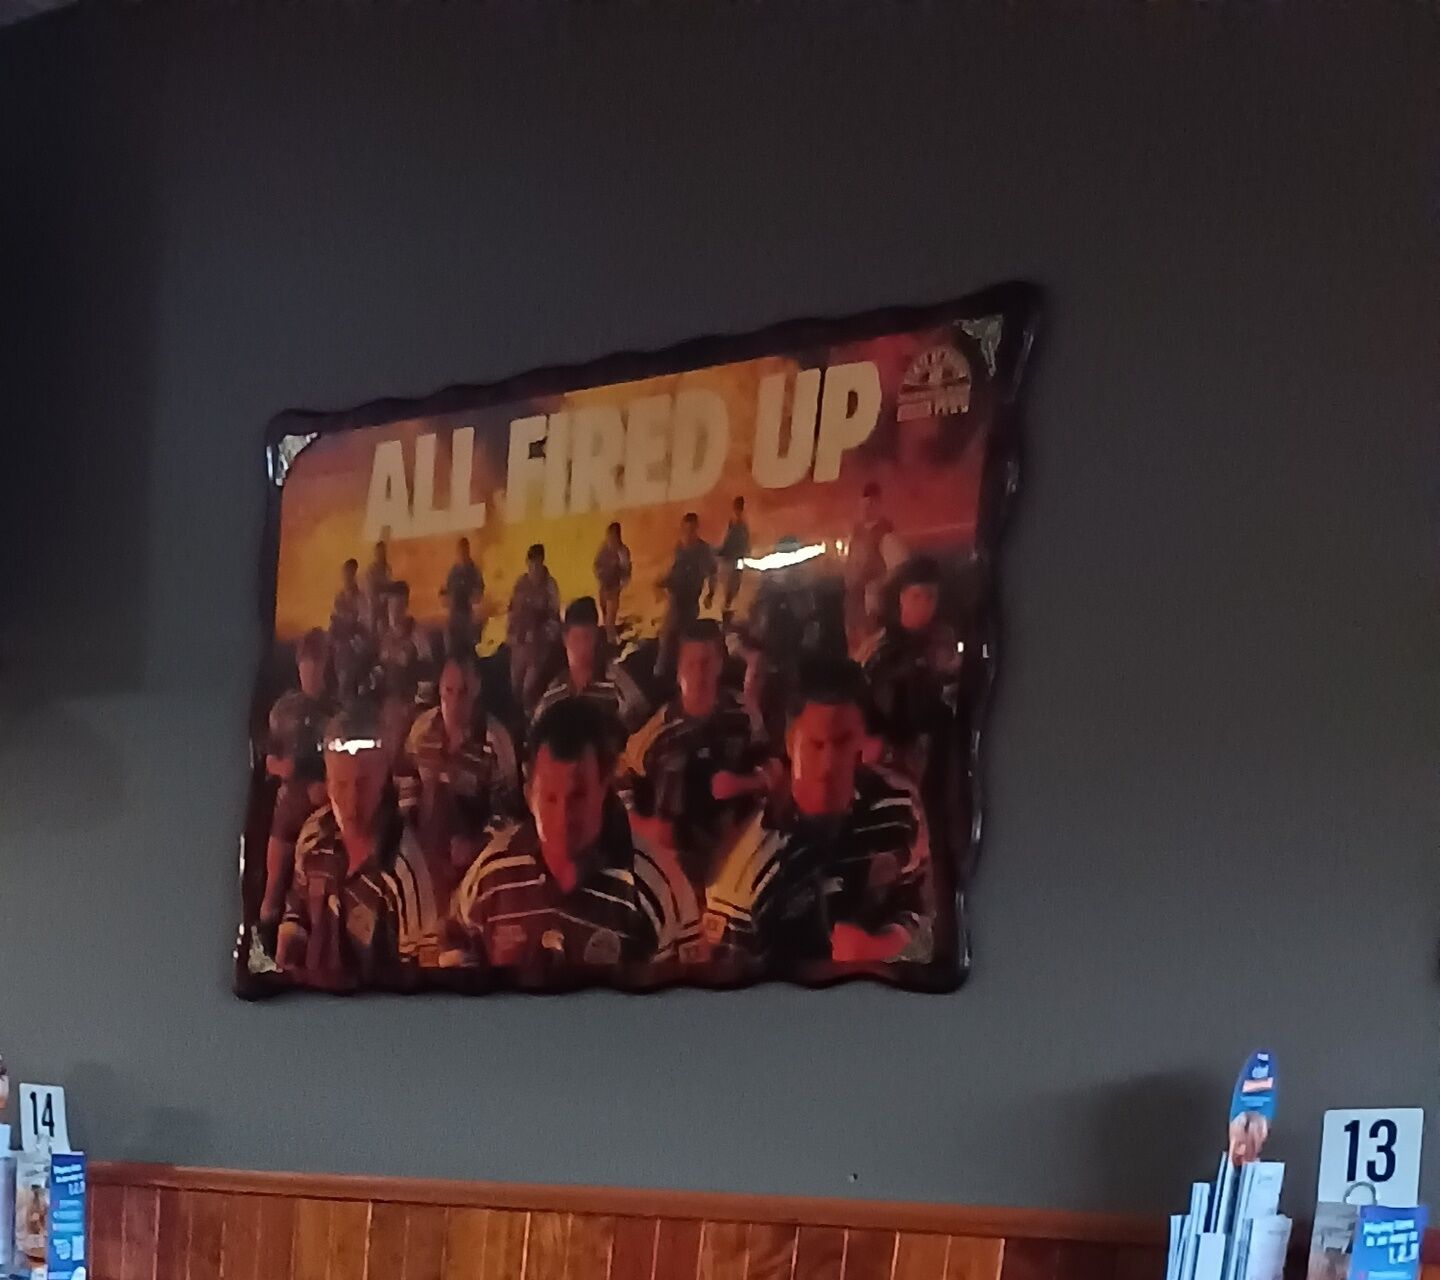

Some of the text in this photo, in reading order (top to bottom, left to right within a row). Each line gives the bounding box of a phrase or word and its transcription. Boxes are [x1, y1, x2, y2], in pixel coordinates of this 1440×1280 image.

[364, 427, 487, 540] ALL
[504, 388, 729, 524] FIRED
[752, 362, 882, 489] UP
[30, 1092, 55, 1137] 14
[1344, 1118, 1397, 1182] 13
